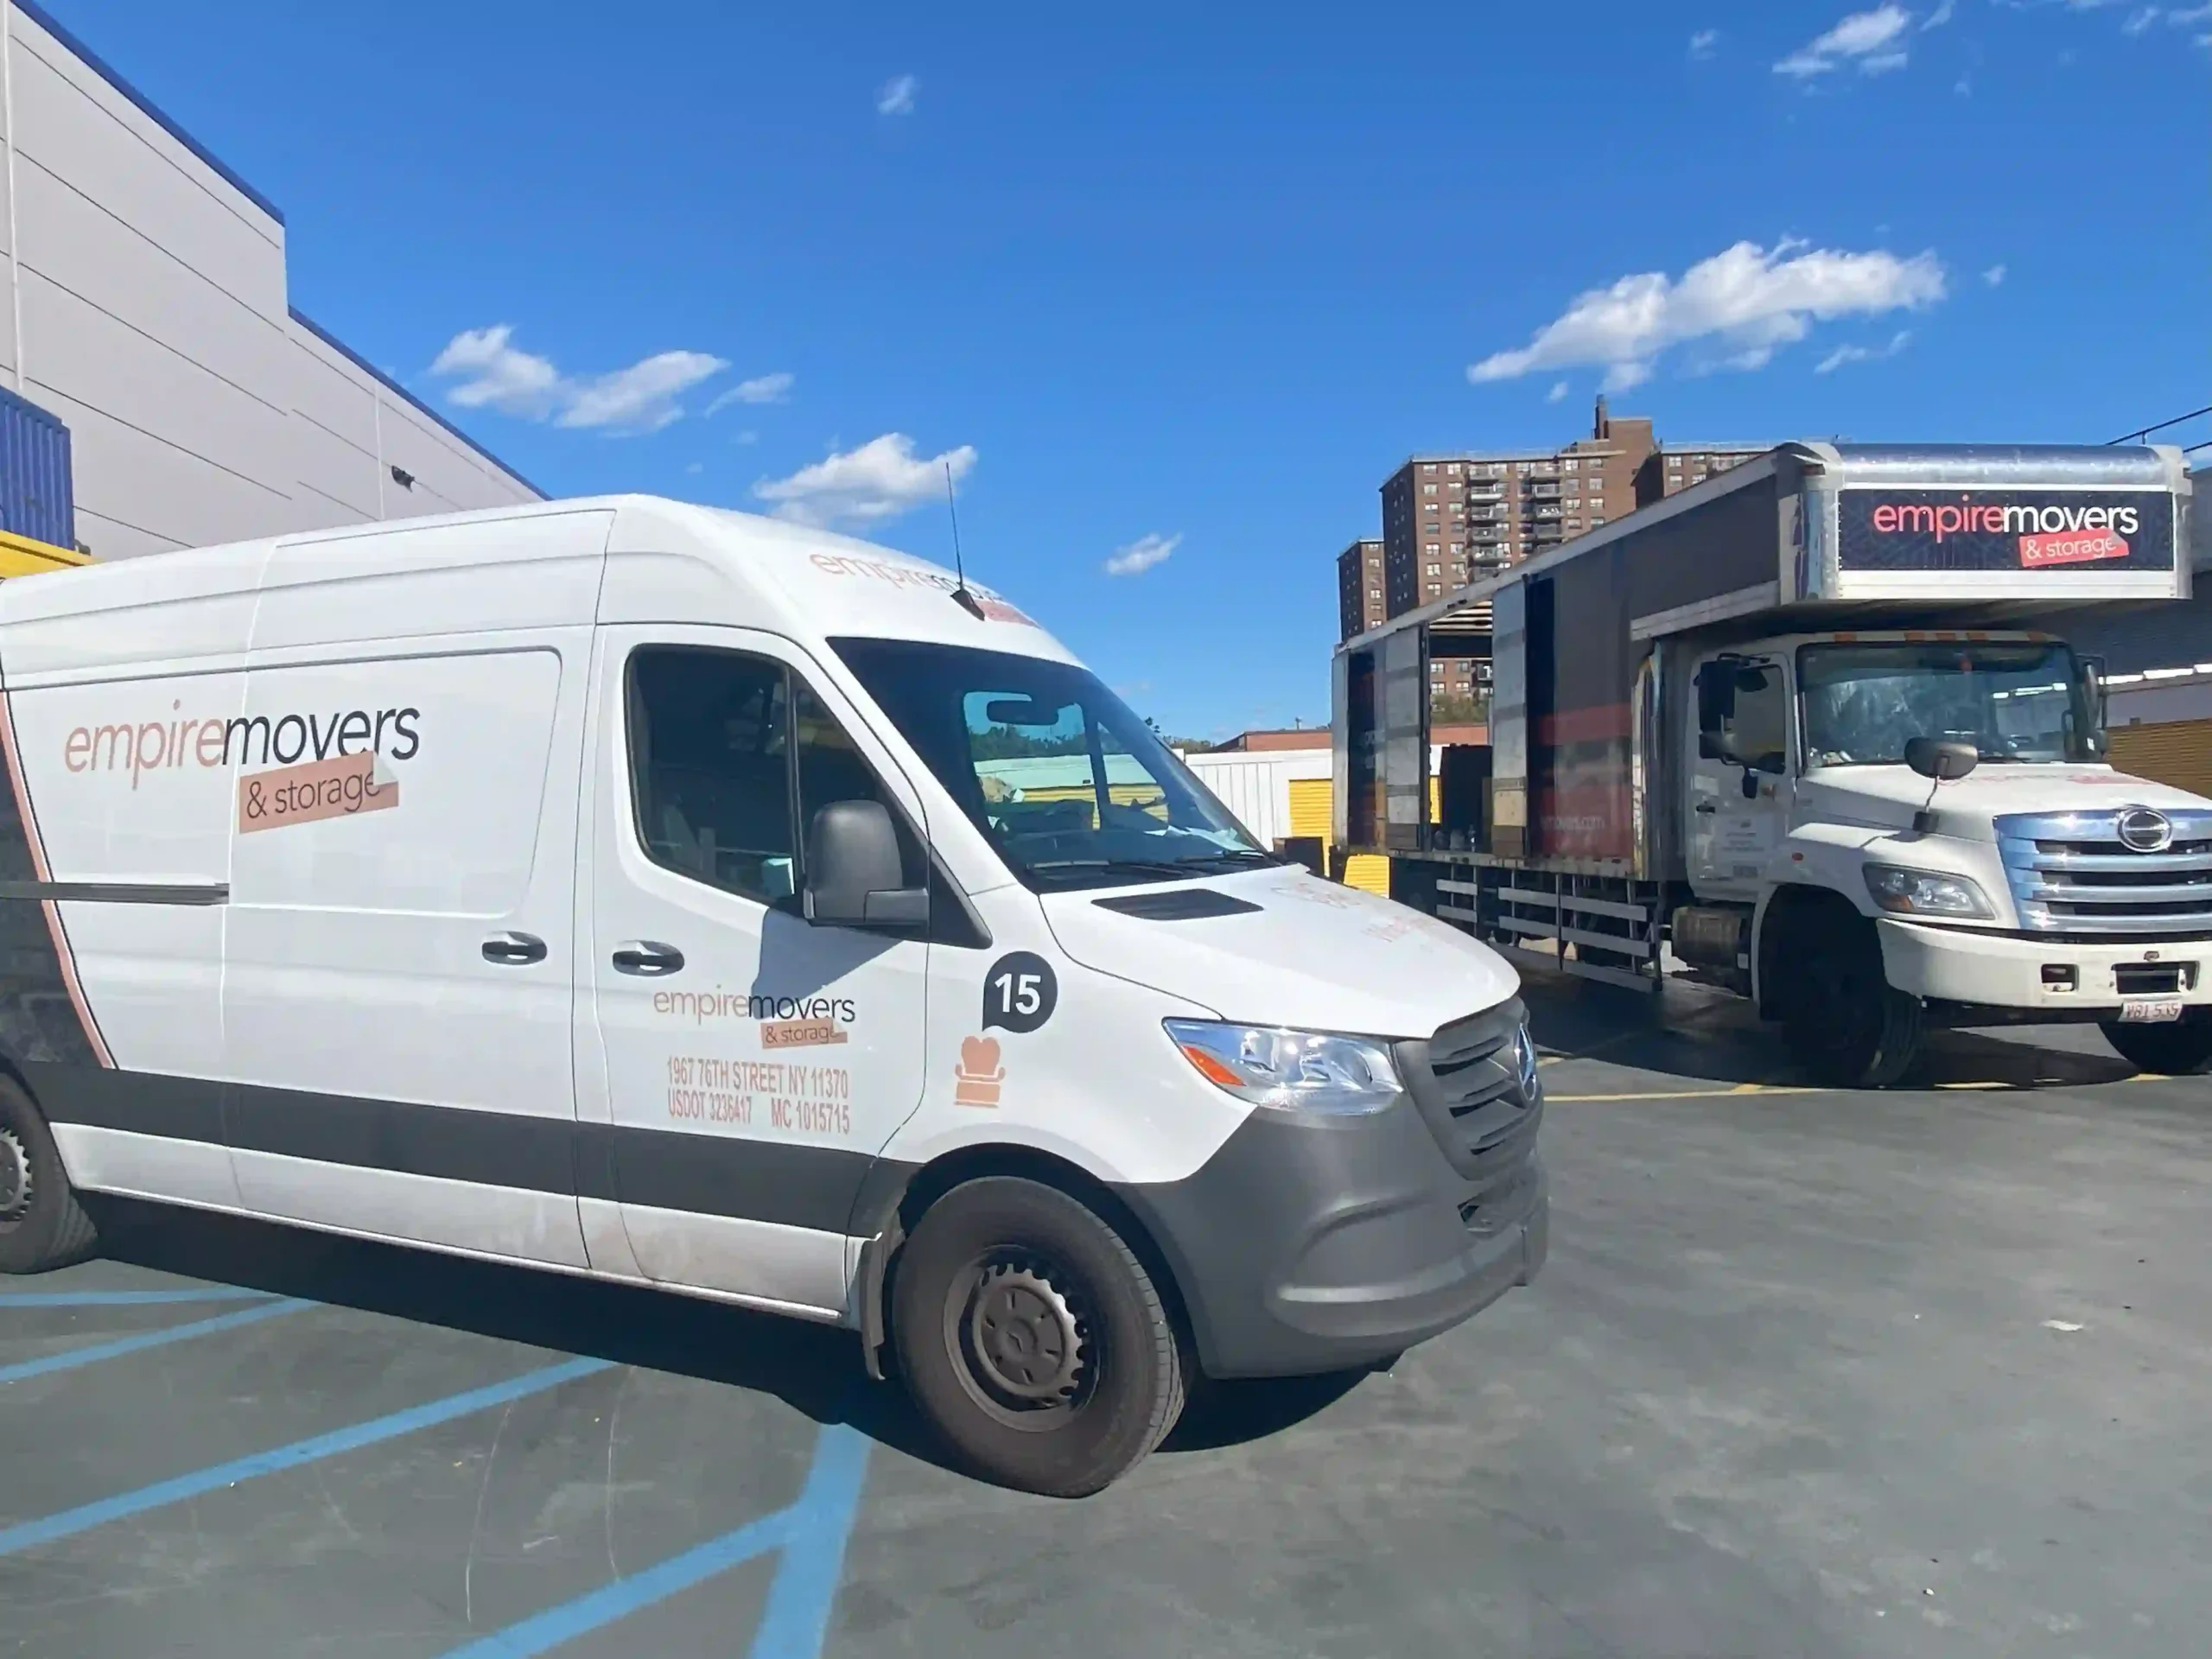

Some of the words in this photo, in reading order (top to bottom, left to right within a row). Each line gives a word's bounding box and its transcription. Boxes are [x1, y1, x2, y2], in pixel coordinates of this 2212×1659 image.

[1872, 494, 2139, 543] empiremovers
[2024, 542, 2042, 560] &
[2046, 537, 2117, 559] storage
[64, 698, 422, 792] empiremovers
[245, 780, 269, 819] &
[274, 770, 380, 815] storage
[653, 983, 855, 1027] empiremovers
[994, 973, 1042, 1014] 15
[765, 1025, 779, 1044] &
[667, 1056, 695, 1085] 1967
[697, 1058, 729, 1089] 76TH
[733, 1061, 785, 1094] STREET
[788, 1064, 807, 1096] NY
[810, 1067, 849, 1099] 11370
[667, 1088, 706, 1119] USDOT
[709, 1092, 753, 1124] 3236417
[771, 1097, 792, 1129] MC
[796, 1100, 851, 1135] 1015715
